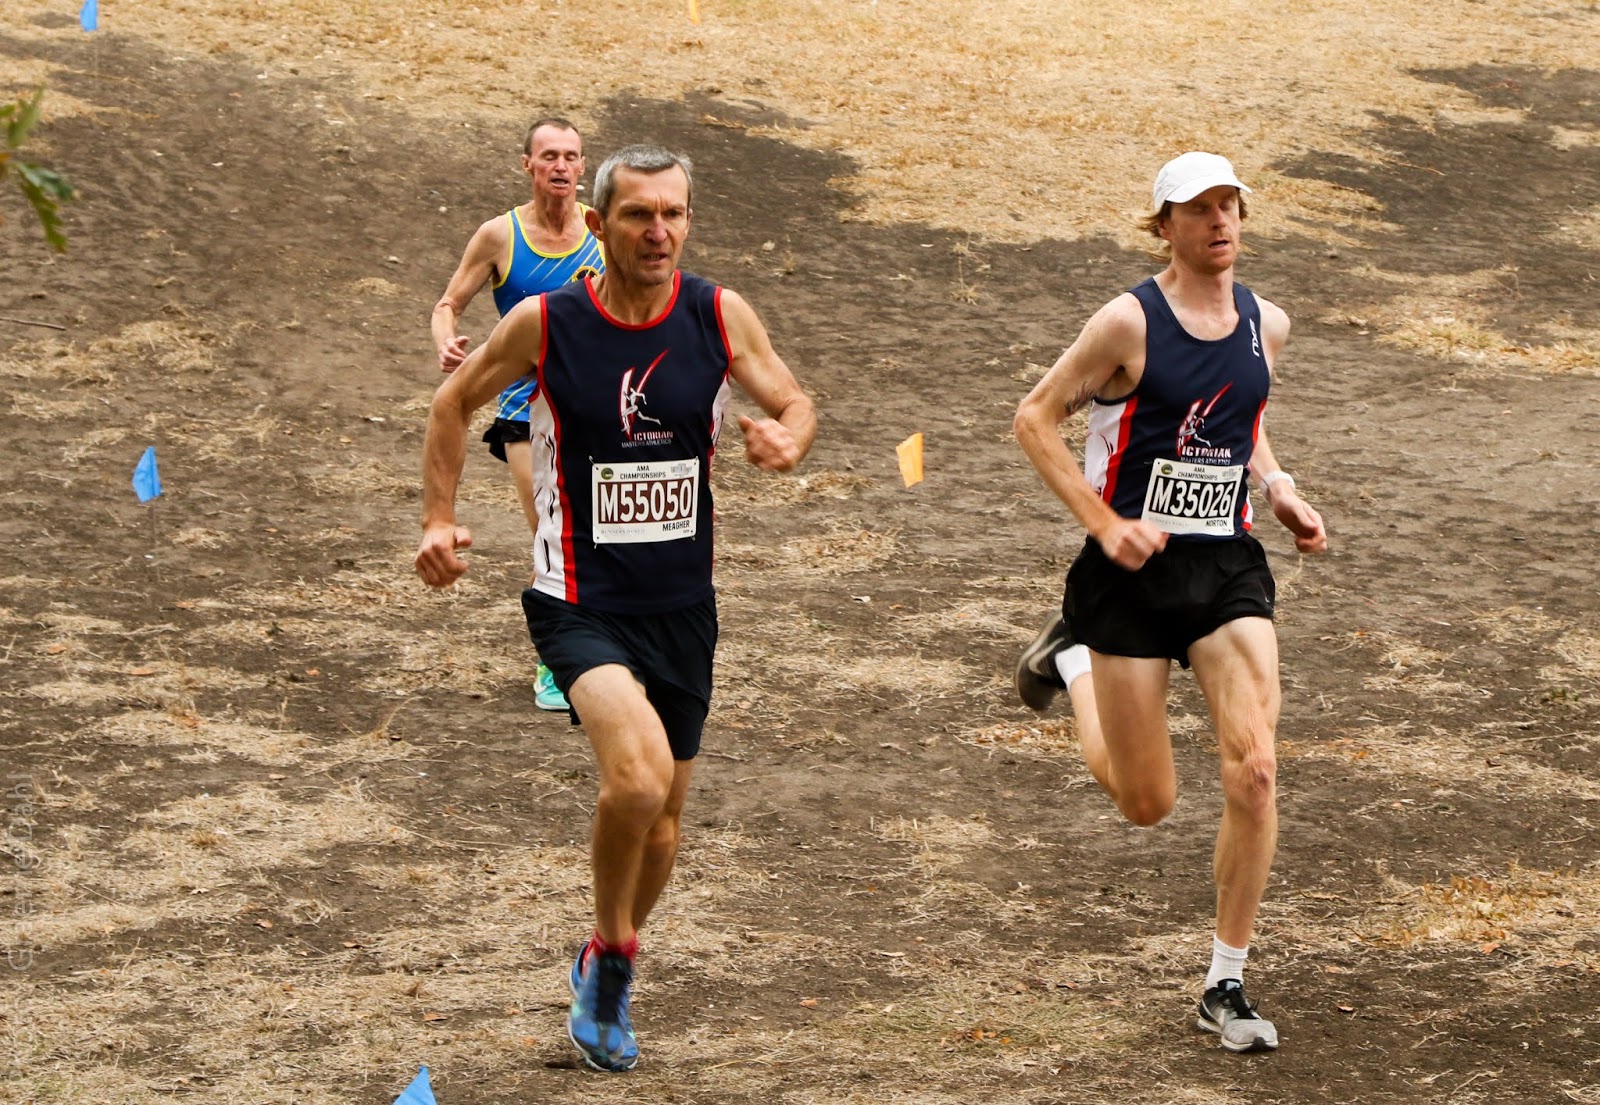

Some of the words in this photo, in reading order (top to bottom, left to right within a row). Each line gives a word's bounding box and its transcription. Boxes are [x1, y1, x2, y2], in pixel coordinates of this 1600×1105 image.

[620, 471, 667, 480] CHAMPIONSHIPS
[1177, 471, 1218, 481] CHAMPIONSHIPS
[600, 479, 692, 522] M55050
[1151, 477, 1235, 518] M35026
[662, 520, 690, 531] MEAGHER
[1205, 519, 1228, 528] NORTON
